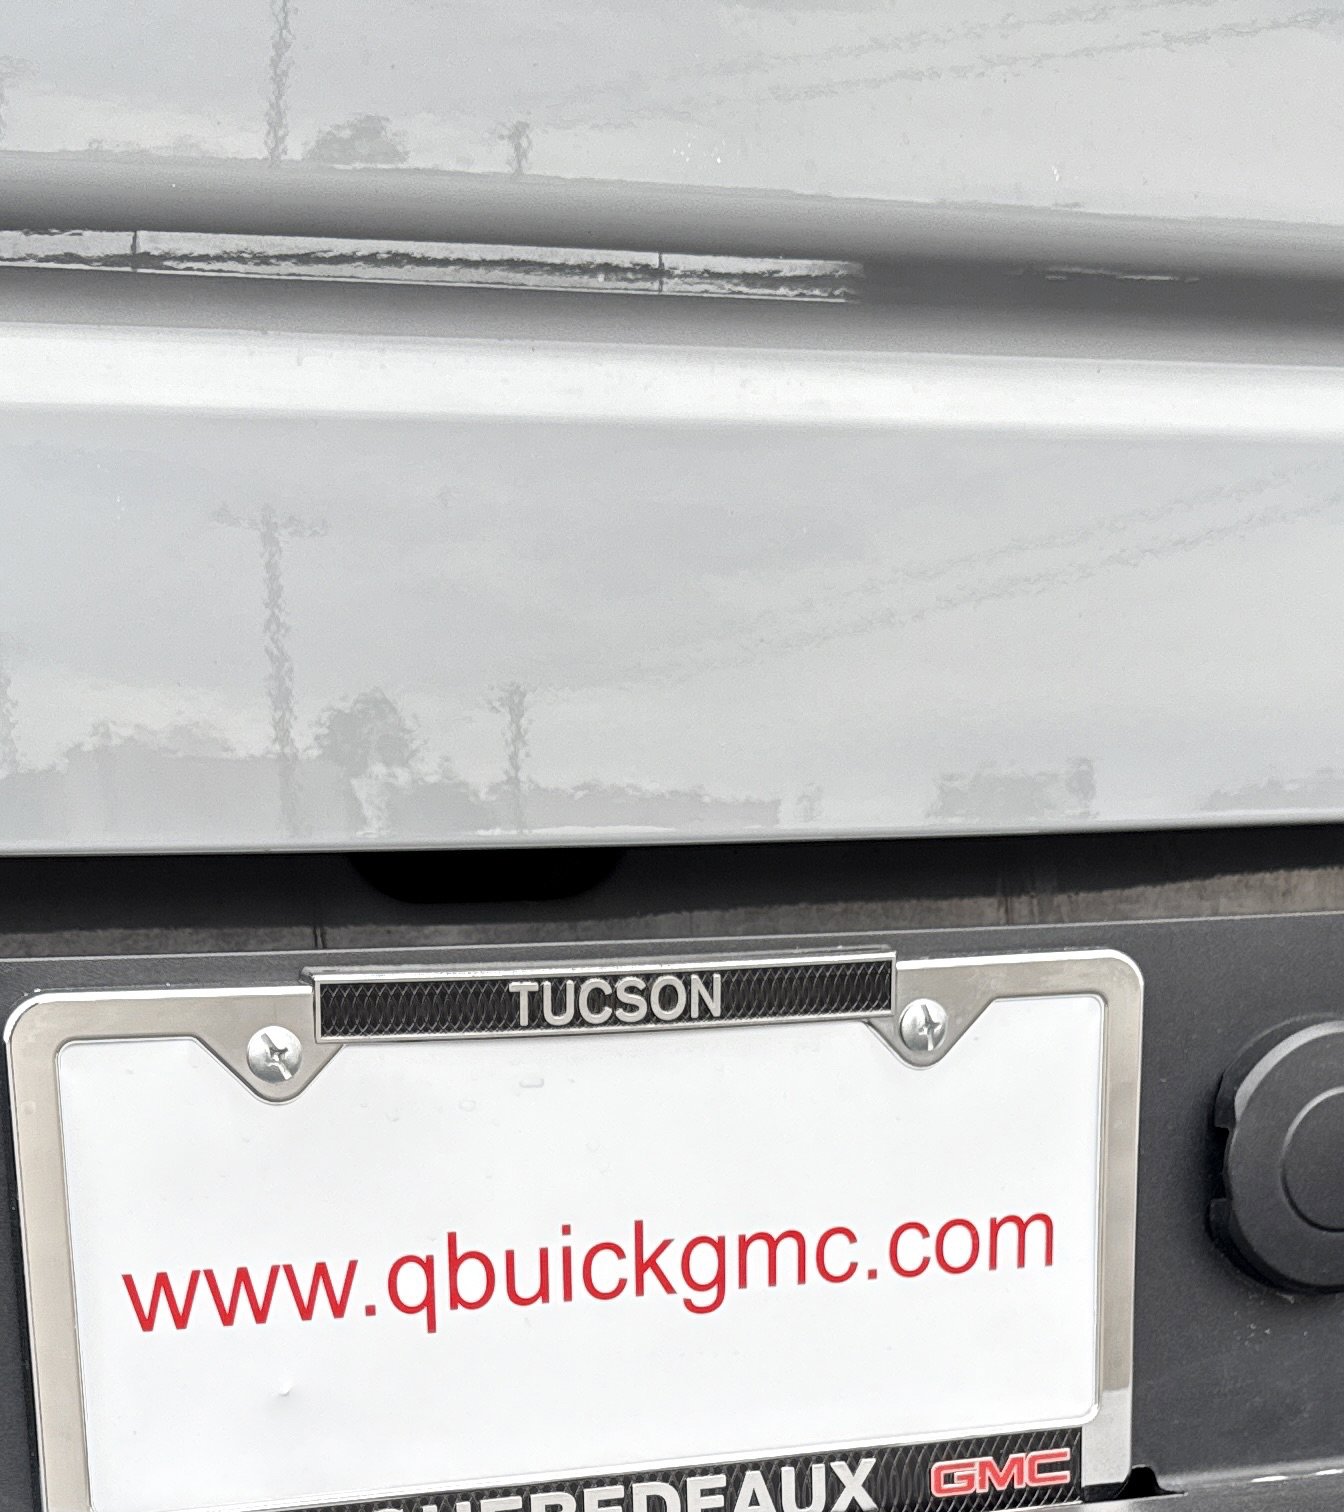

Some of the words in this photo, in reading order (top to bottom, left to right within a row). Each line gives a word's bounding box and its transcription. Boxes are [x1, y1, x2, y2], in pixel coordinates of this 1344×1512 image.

[508, 973, 722, 1027] TUCSON
[122, 1212, 1055, 1333] www.qbuickgmc.com
[930, 1448, 1071, 1498] GMC
